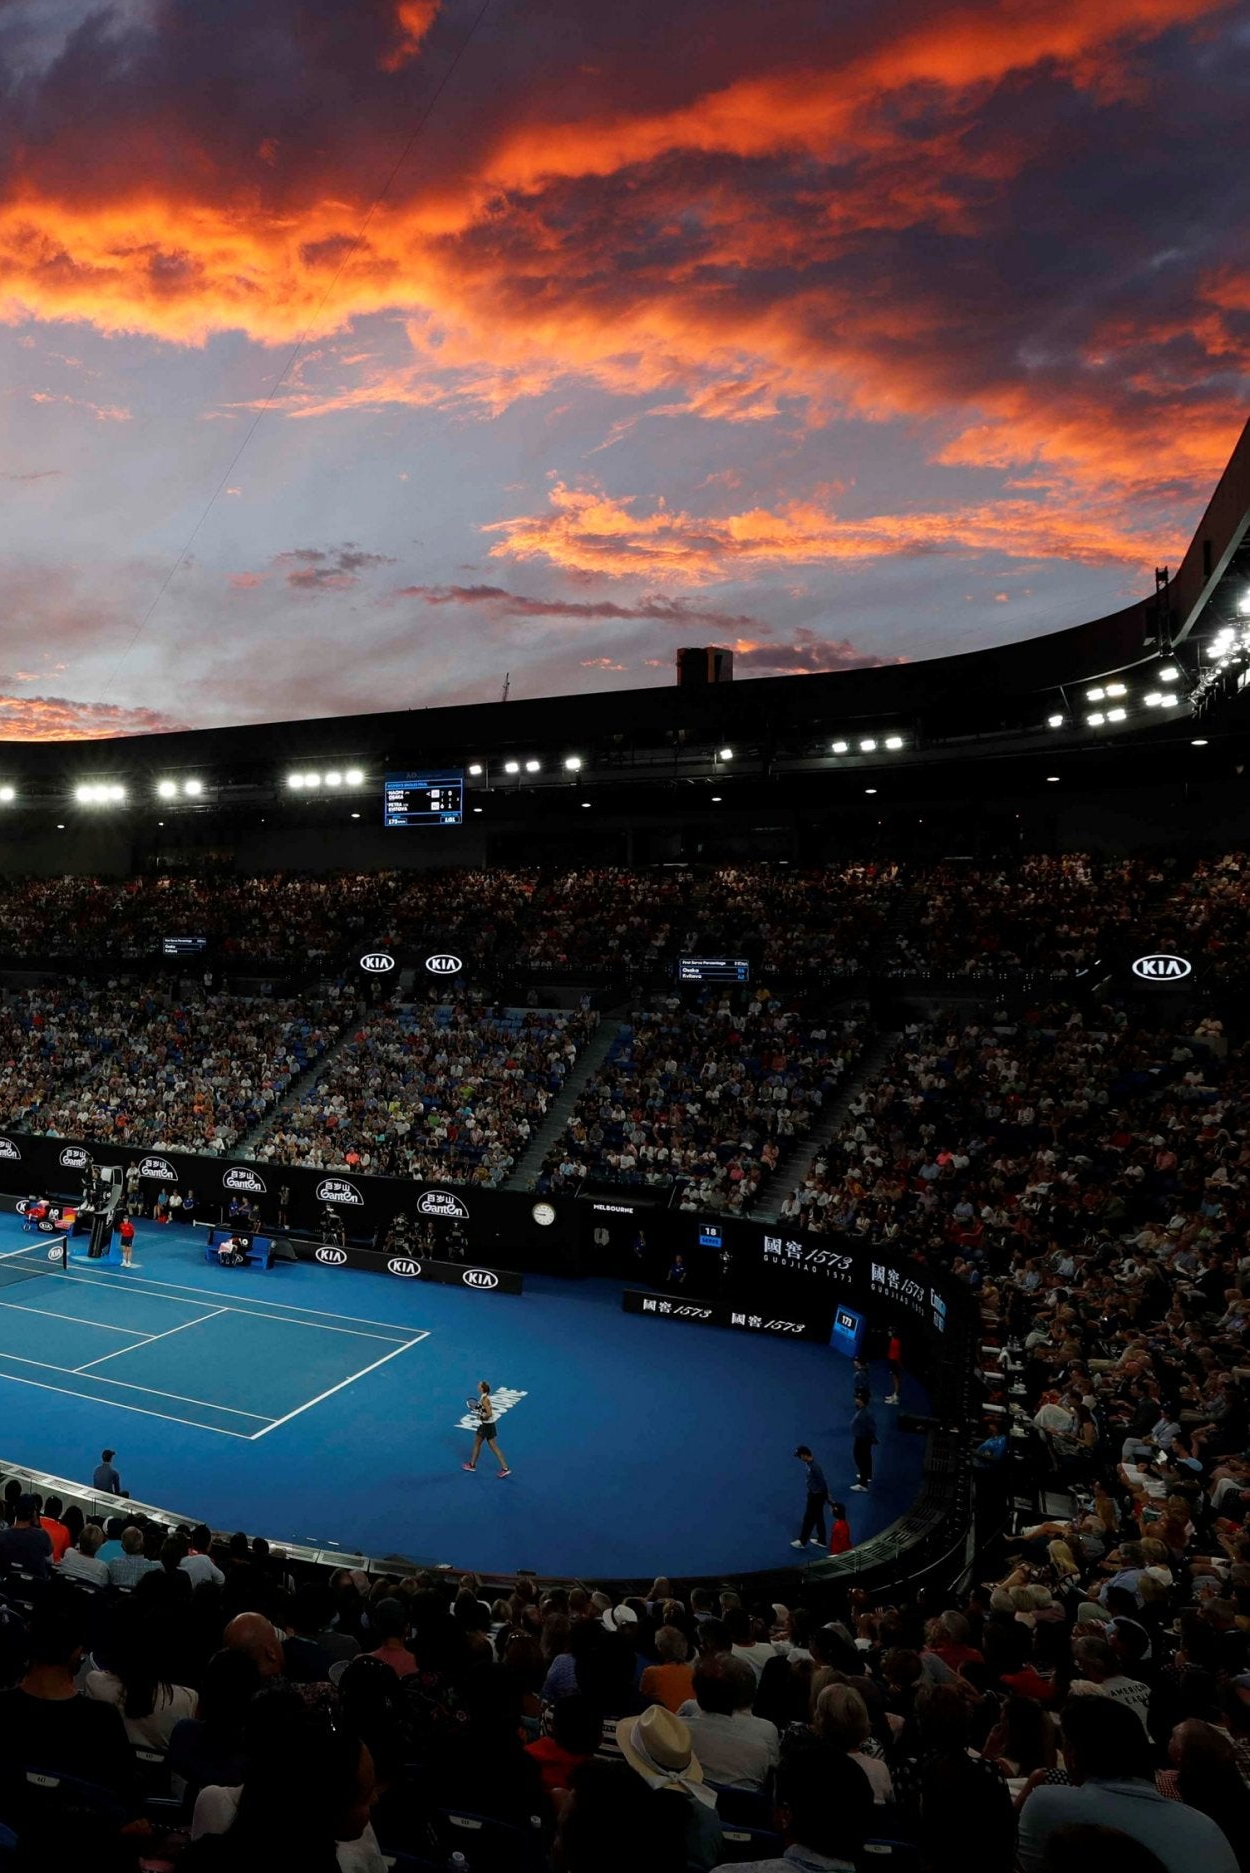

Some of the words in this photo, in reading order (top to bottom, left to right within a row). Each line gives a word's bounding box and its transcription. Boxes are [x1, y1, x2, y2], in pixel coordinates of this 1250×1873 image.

[366, 957, 389, 967] KIA
[431, 958, 456, 969] KIA
[1142, 960, 1181, 975] KIA
[593, 1204, 634, 1214] MELBOURNE
[705, 1227, 716, 1236] 18
[321, 1250, 341, 1262] KIA
[393, 1261, 415, 1273] KIA
[764, 1255, 817, 1273] GUOJIAO
[468, 1272, 492, 1285] KIA
[842, 1315, 852, 1327] 173
